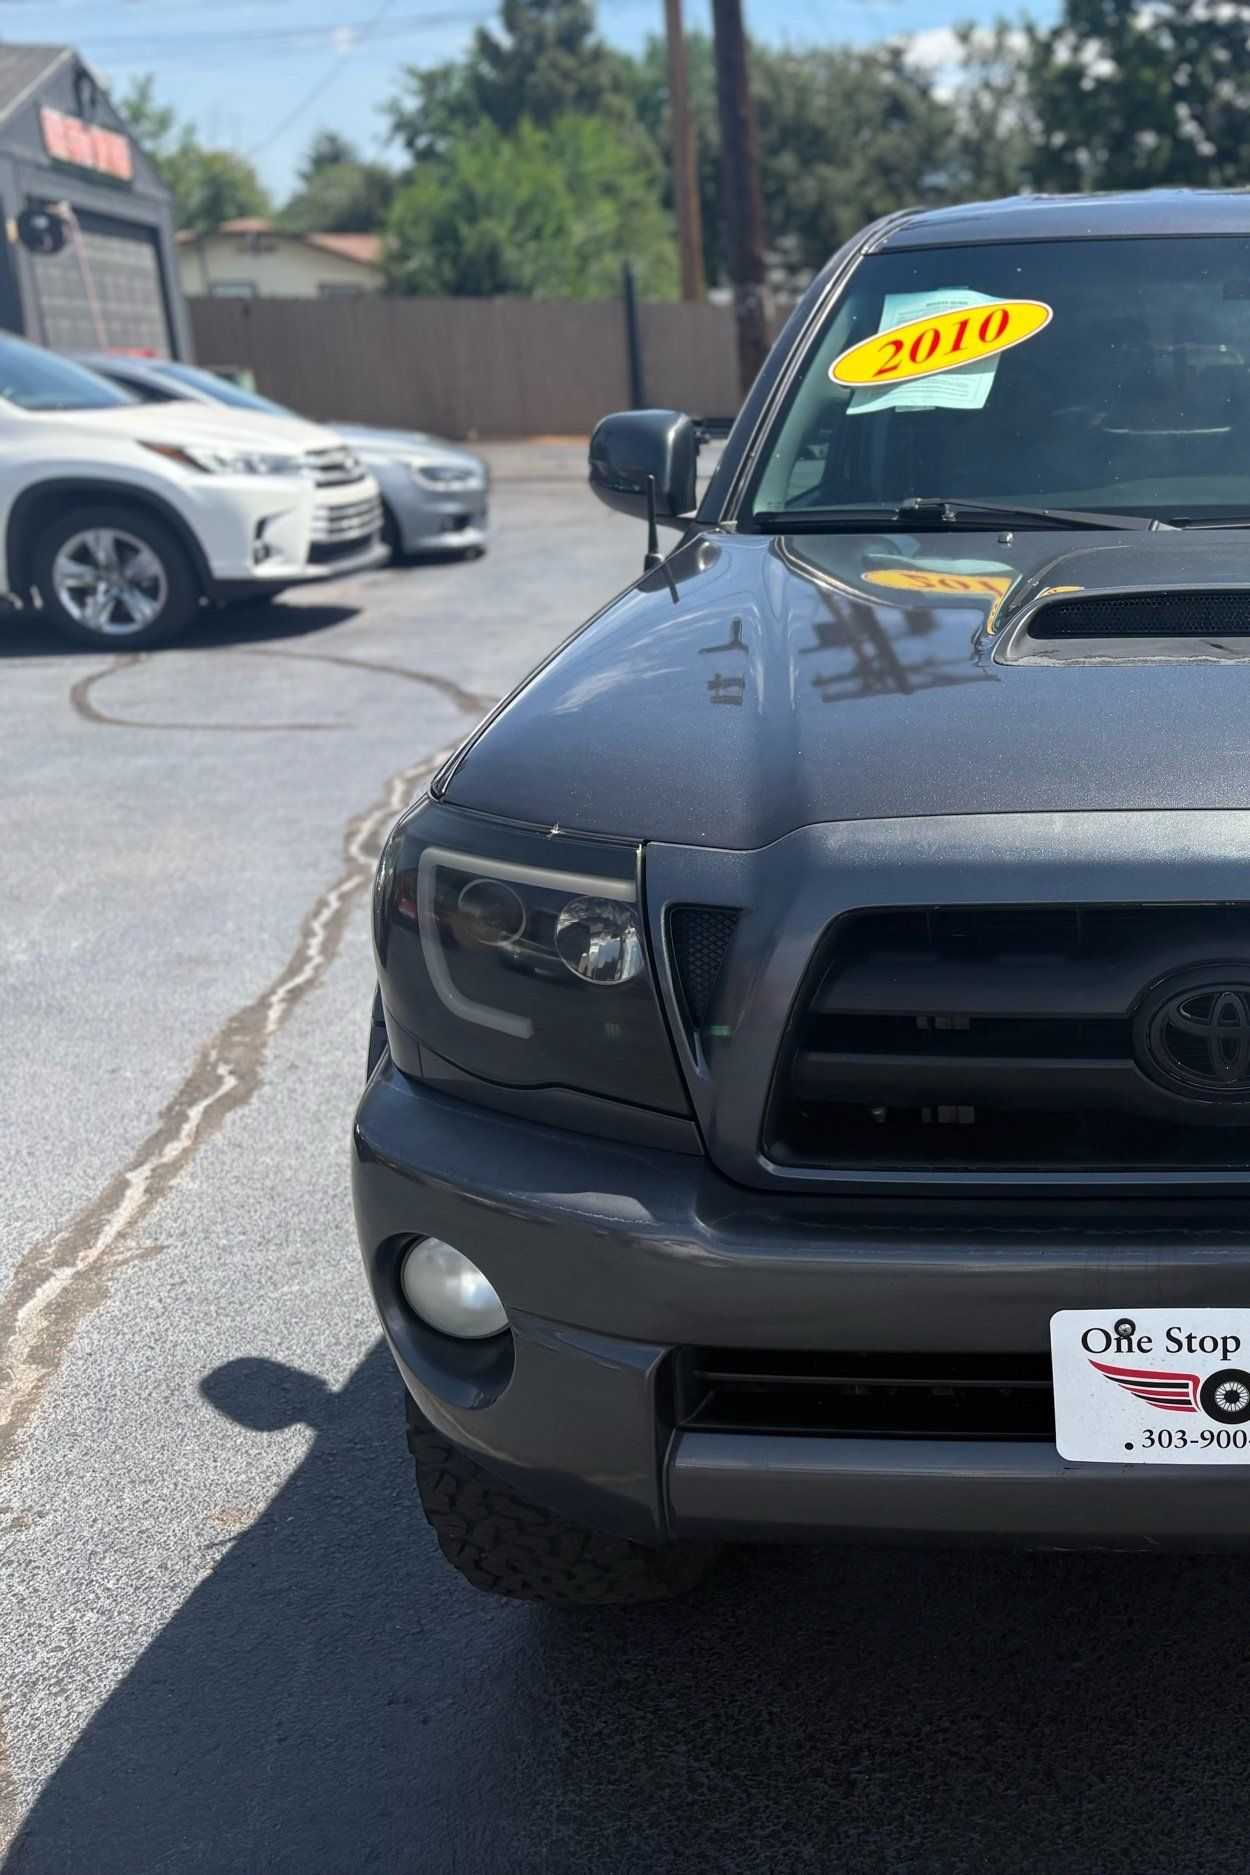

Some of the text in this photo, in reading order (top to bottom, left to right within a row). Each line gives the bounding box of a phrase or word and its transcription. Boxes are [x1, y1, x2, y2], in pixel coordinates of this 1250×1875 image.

[872, 308, 1010, 378] 2010
[1081, 1327, 1154, 1354] One
[1165, 1326, 1241, 1361] Stop
